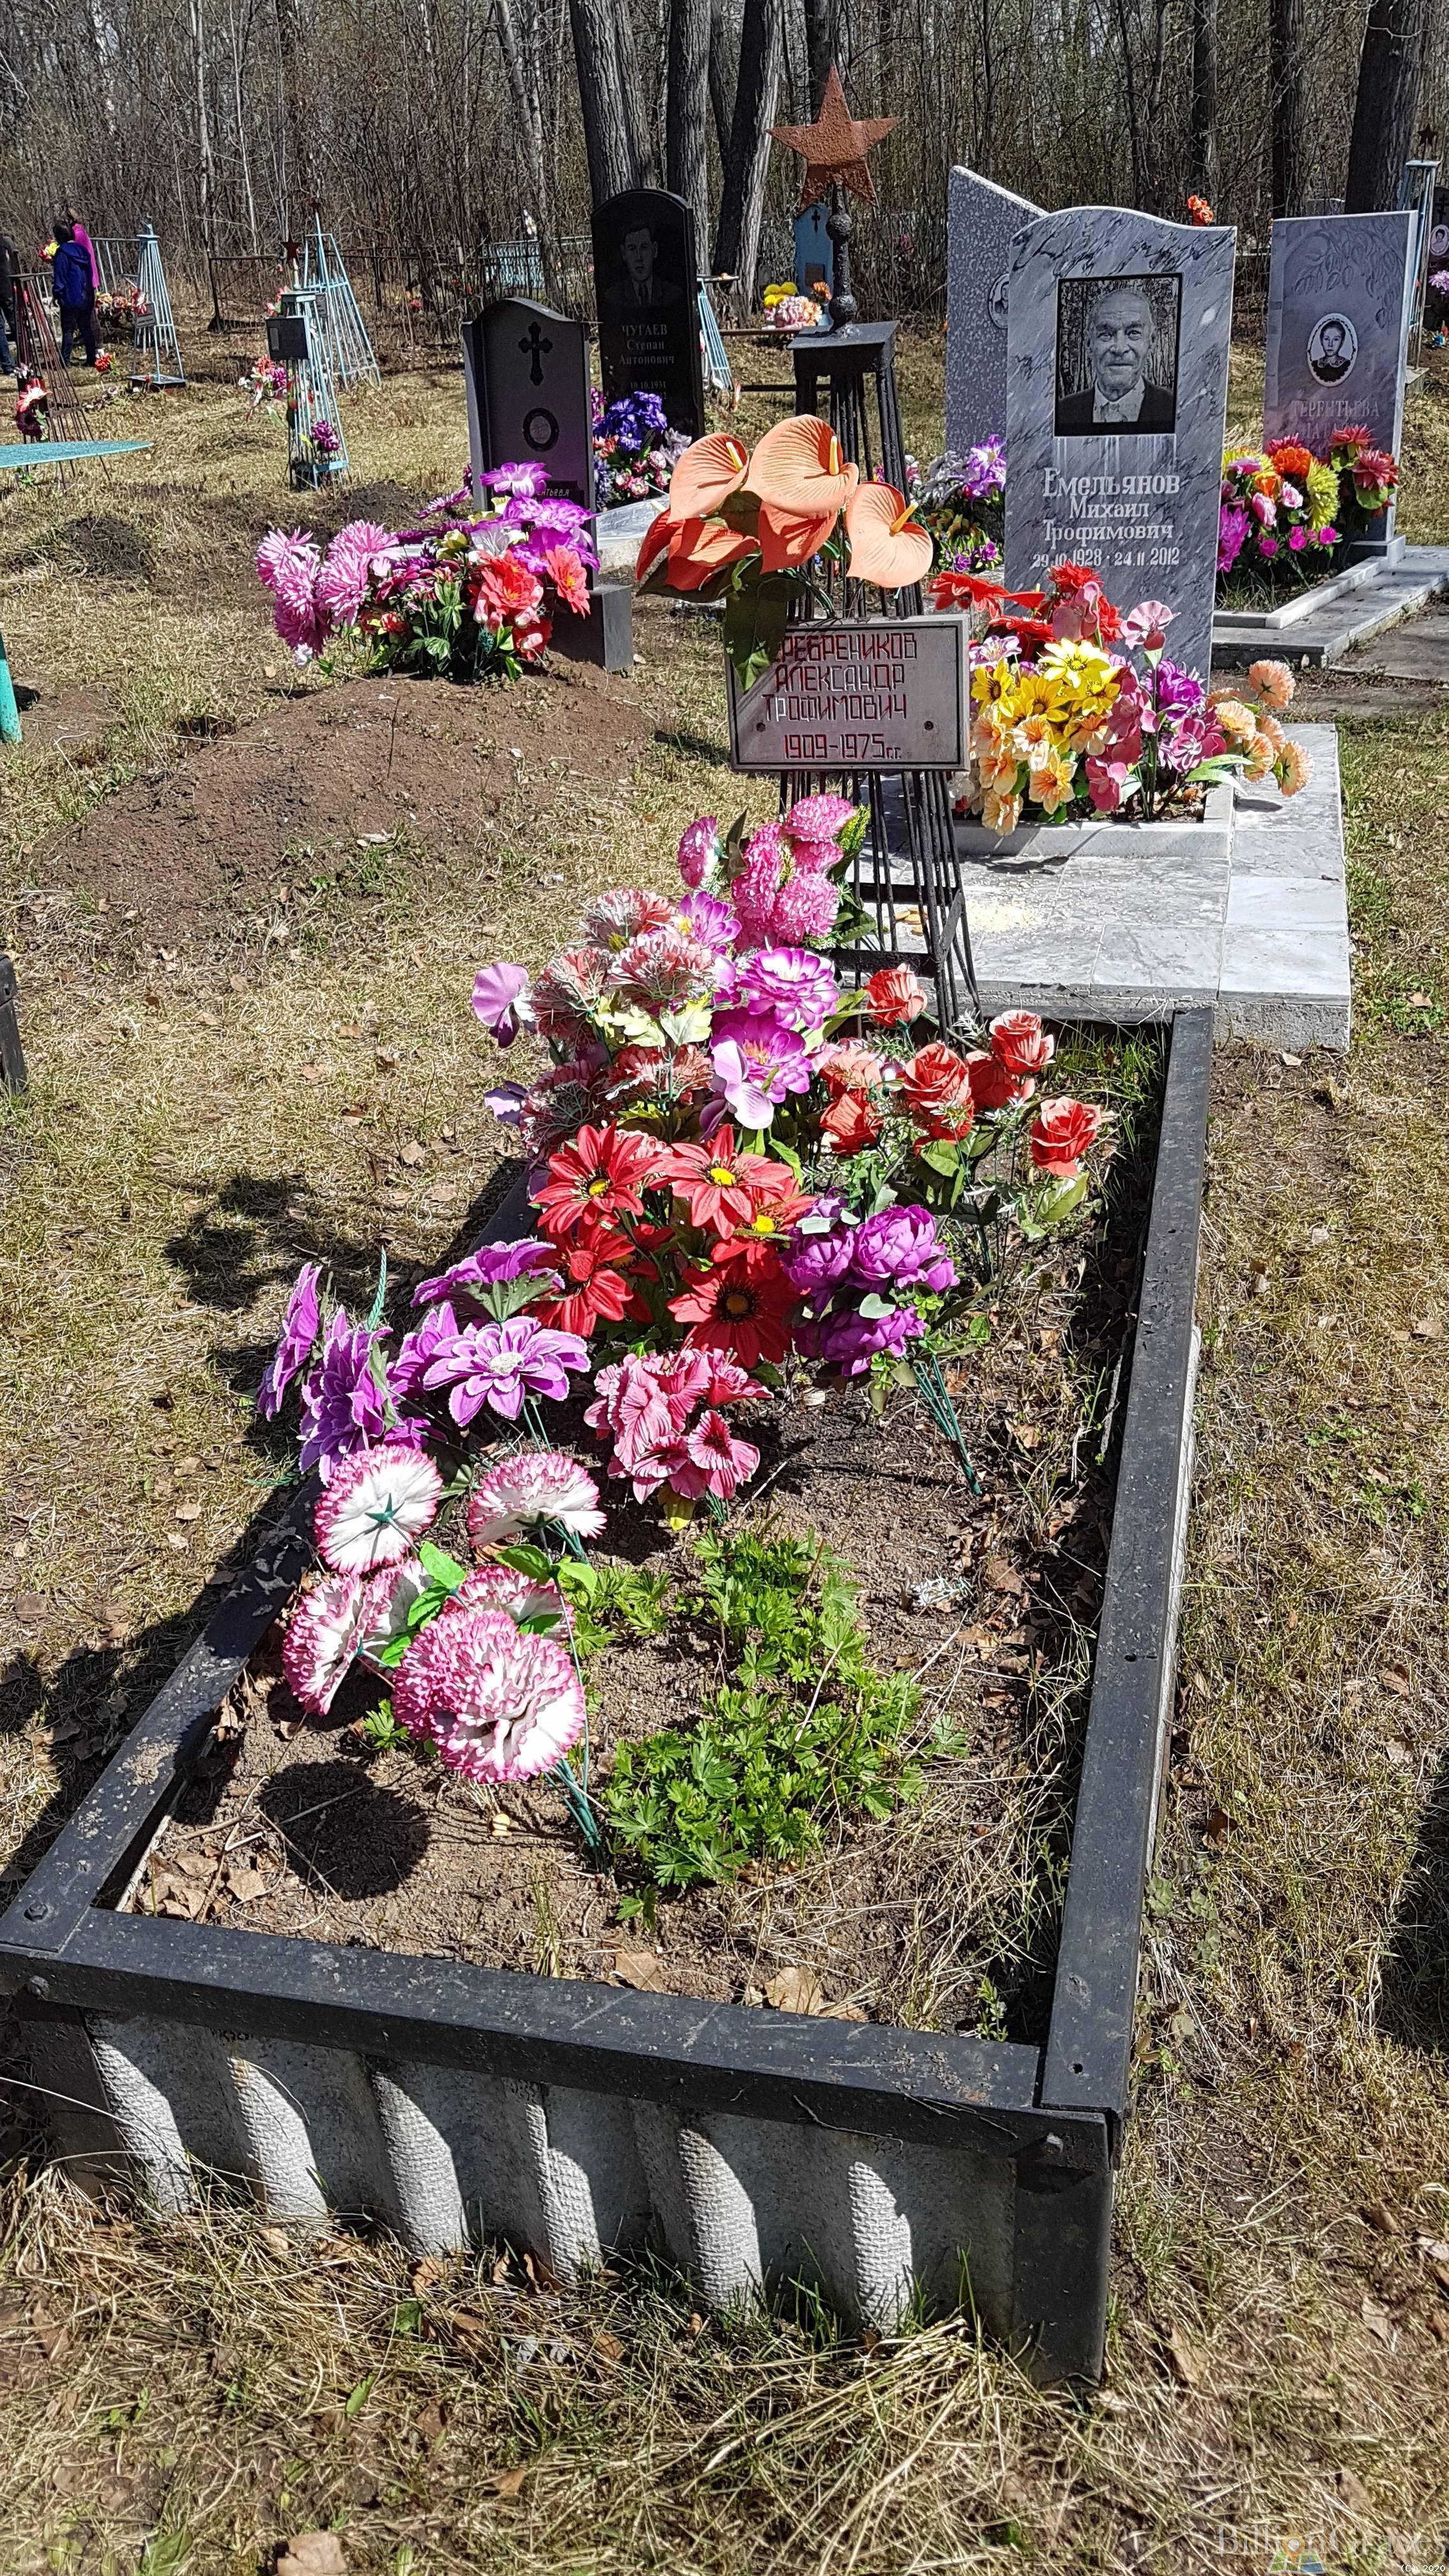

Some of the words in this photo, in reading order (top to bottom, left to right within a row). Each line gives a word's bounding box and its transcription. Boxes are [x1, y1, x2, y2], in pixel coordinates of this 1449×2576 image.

[622, 324, 668, 336] ЧУГАЕВ
[627, 339, 664, 350] Степан
[619, 354, 675, 365] Антонович
[1043, 467, 1181, 497] Емельянов
[1069, 496, 1150, 518] Михаил
[1043, 519, 1174, 549] Трофимович
[1032, 548, 1102, 568] 29.101928
[771, 632, 917, 663] РЕБРЕНИКОВ
[775, 664, 905, 693] АЛЕКСАНДР
[762, 694, 907, 722] ТРОФИМОВИЧ
